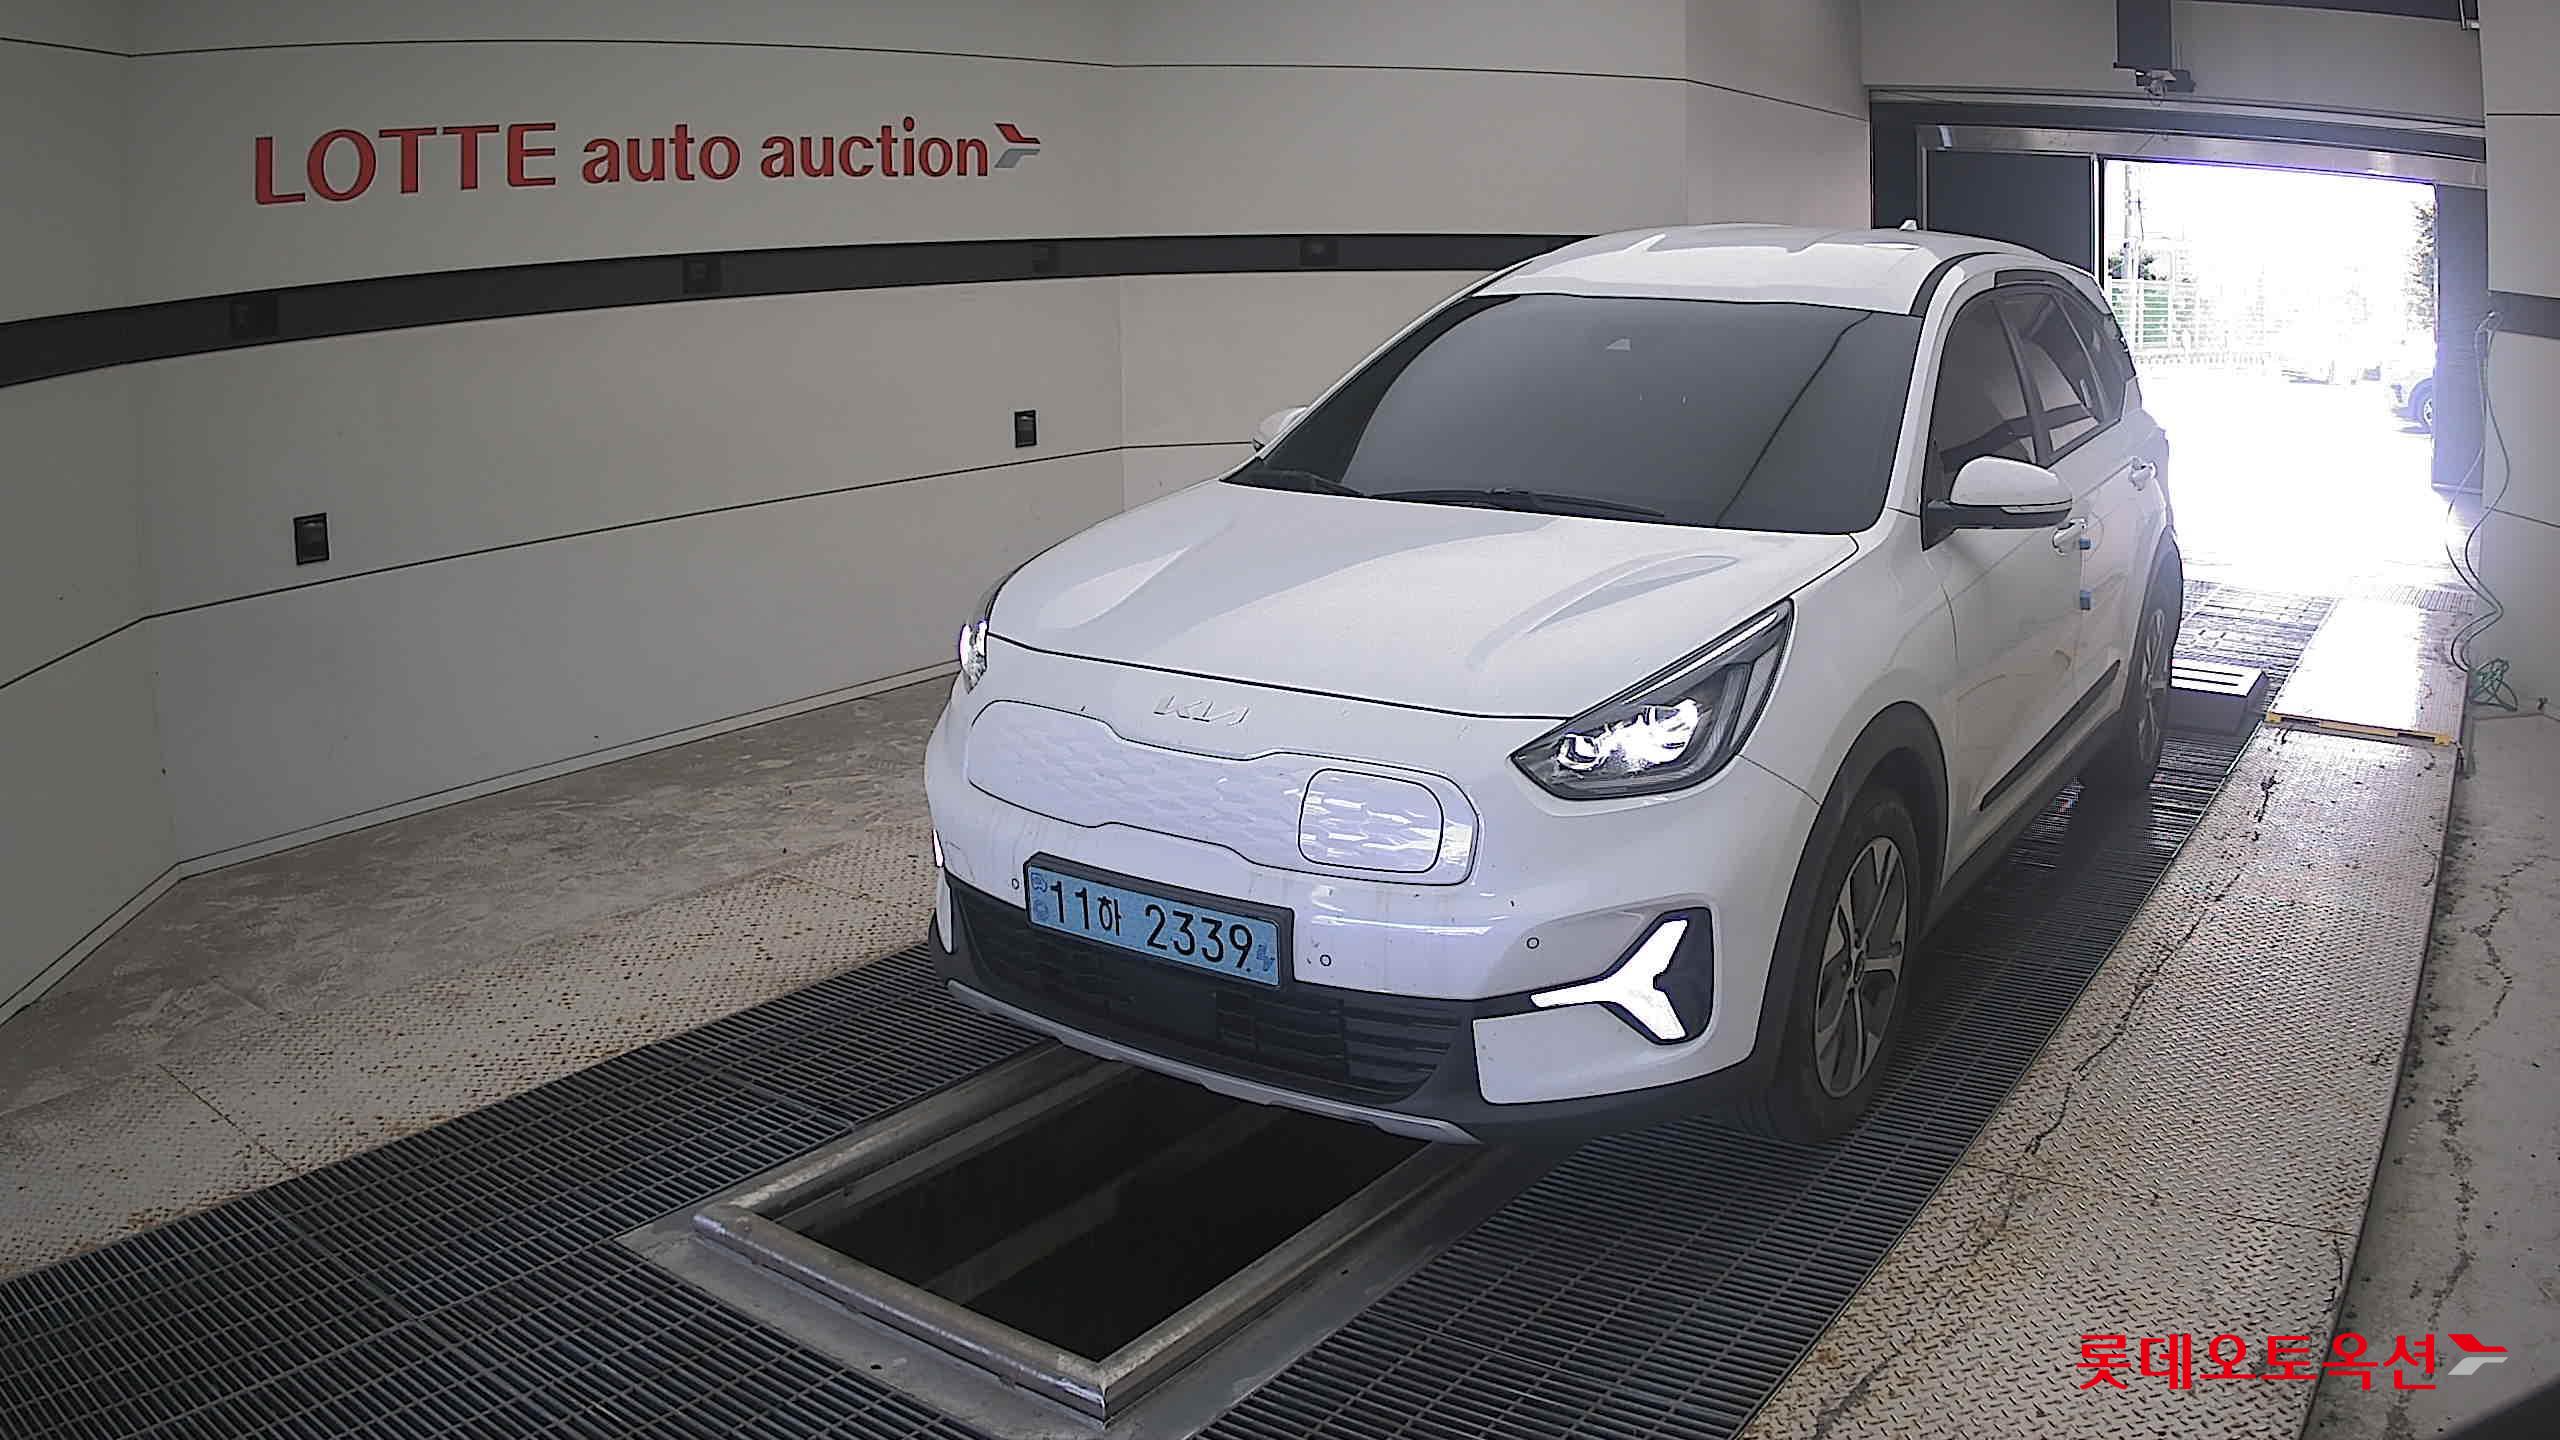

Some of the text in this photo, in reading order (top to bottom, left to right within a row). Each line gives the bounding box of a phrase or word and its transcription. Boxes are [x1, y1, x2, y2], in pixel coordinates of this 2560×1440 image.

[254, 116, 989, 207] LOTTE auto auction
[1049, 879, 1254, 970] 11하 2339
